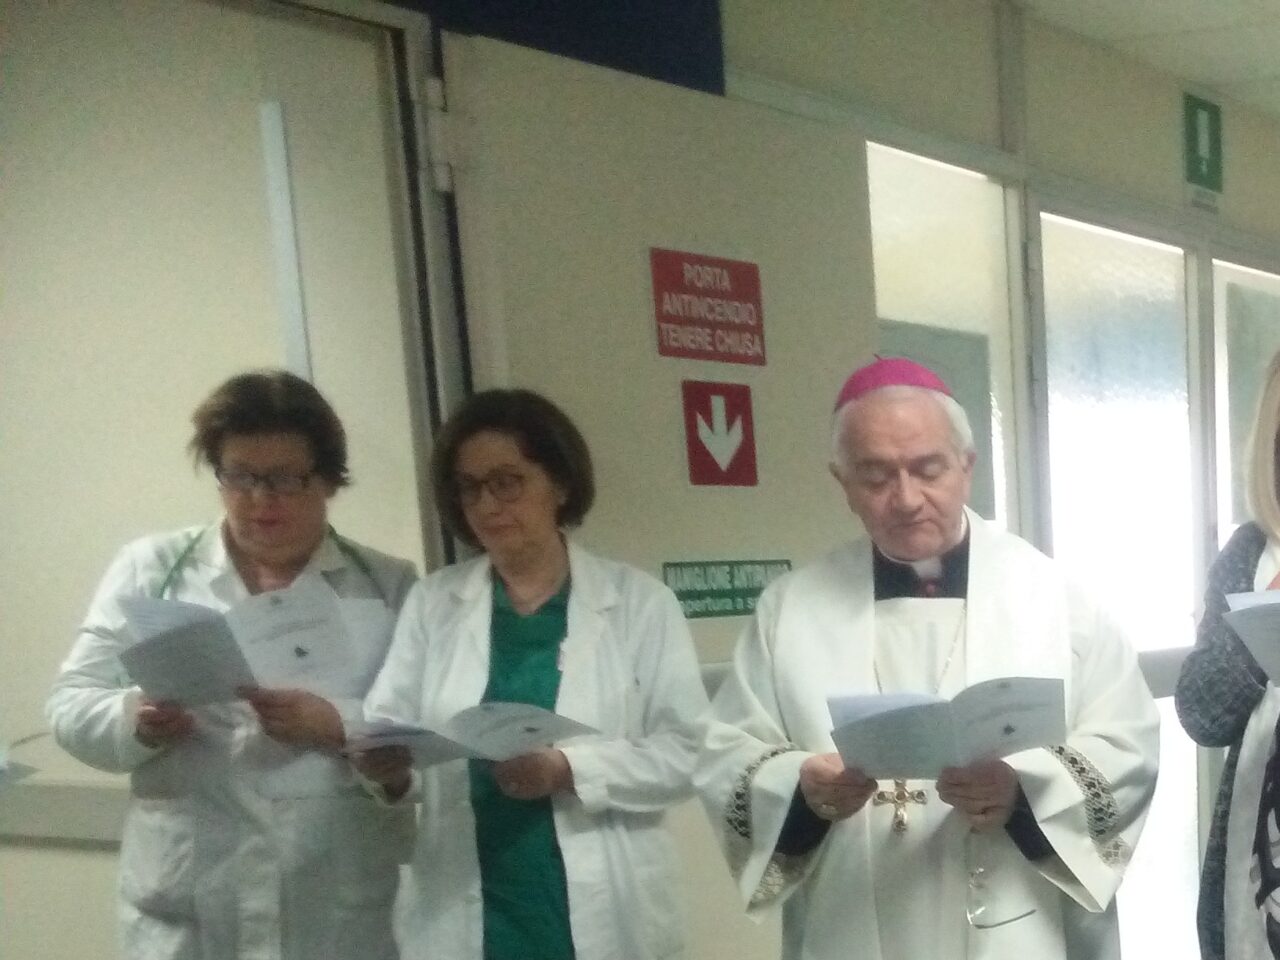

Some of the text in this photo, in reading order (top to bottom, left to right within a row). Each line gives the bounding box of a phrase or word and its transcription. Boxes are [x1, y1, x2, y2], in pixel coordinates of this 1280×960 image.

[682, 262, 731, 291] PORTA
[662, 292, 756, 326] ANTINCENDIO
[660, 322, 763, 356] TENERE CHIUSA
[681, 598, 733, 614] pertura
